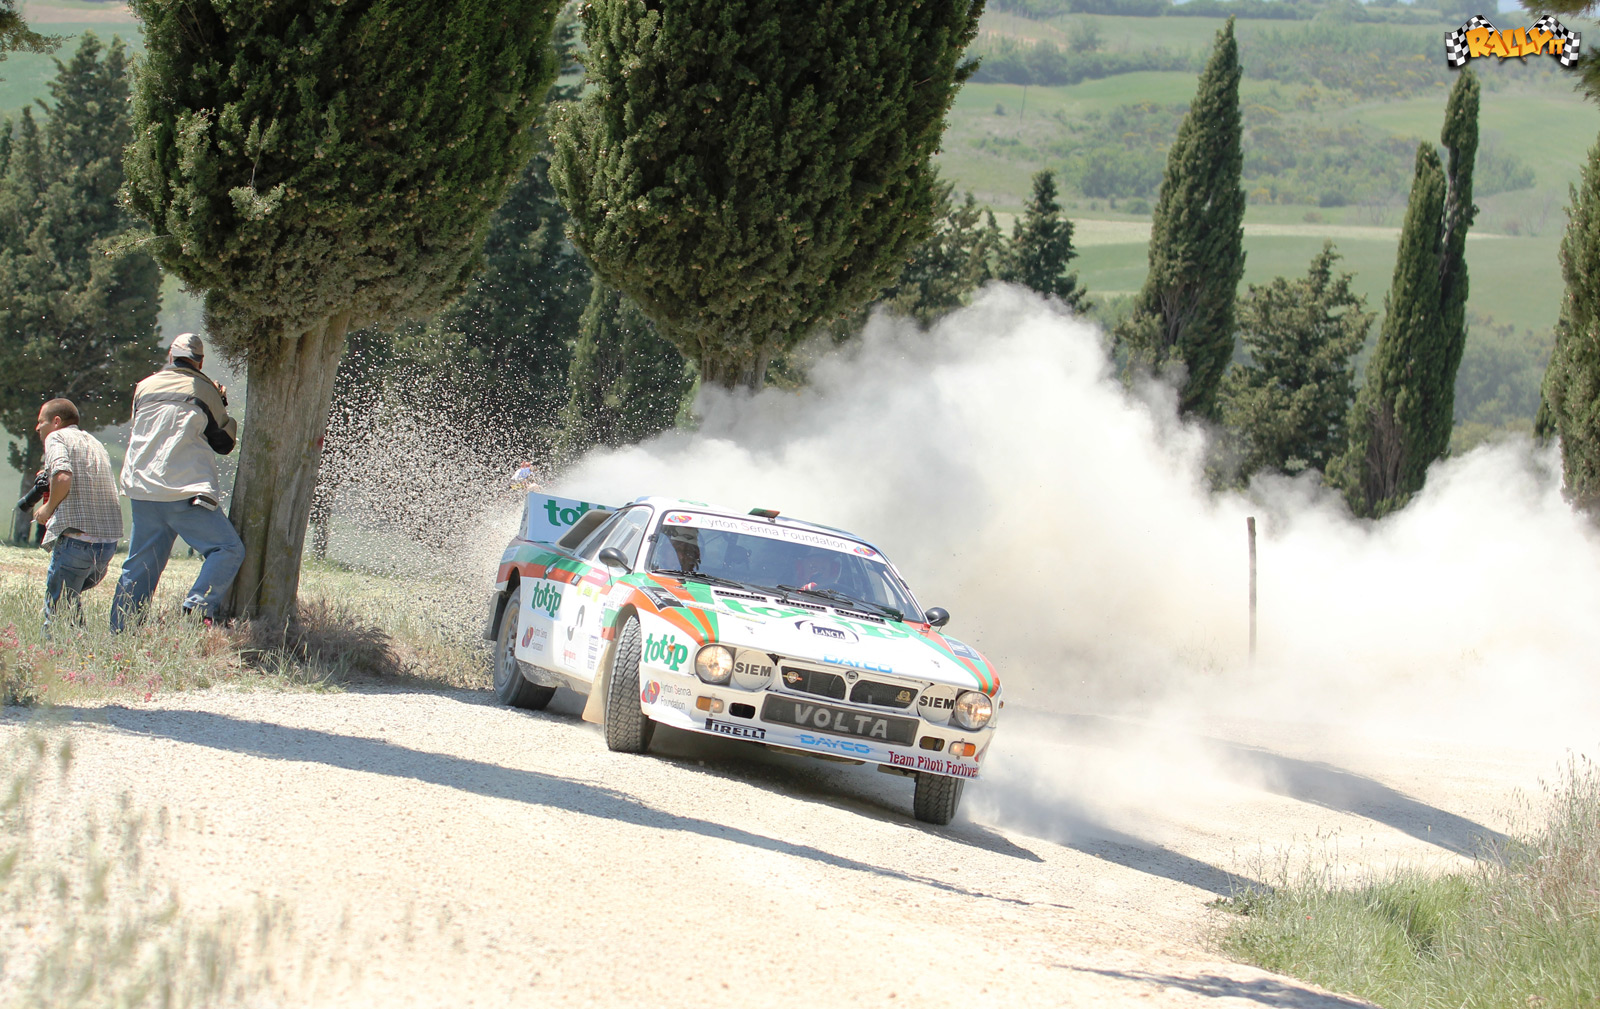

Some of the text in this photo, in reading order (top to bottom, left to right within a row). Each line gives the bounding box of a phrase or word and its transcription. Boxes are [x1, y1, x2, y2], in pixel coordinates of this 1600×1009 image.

[700, 515, 848, 550] Ayrton Senna Foundation
[532, 581, 562, 618] totip
[814, 628, 846, 640] LANCIA
[643, 632, 688, 672] totip
[735, 661, 772, 678] SIEM
[918, 695, 955, 710] SIEM
[705, 718, 767, 740] PIRELLI
[794, 703, 888, 739] VOLTA
[799, 733, 872, 755] DAYCO
[888, 750, 915, 768] Team
[917, 755, 944, 773] Piloti
